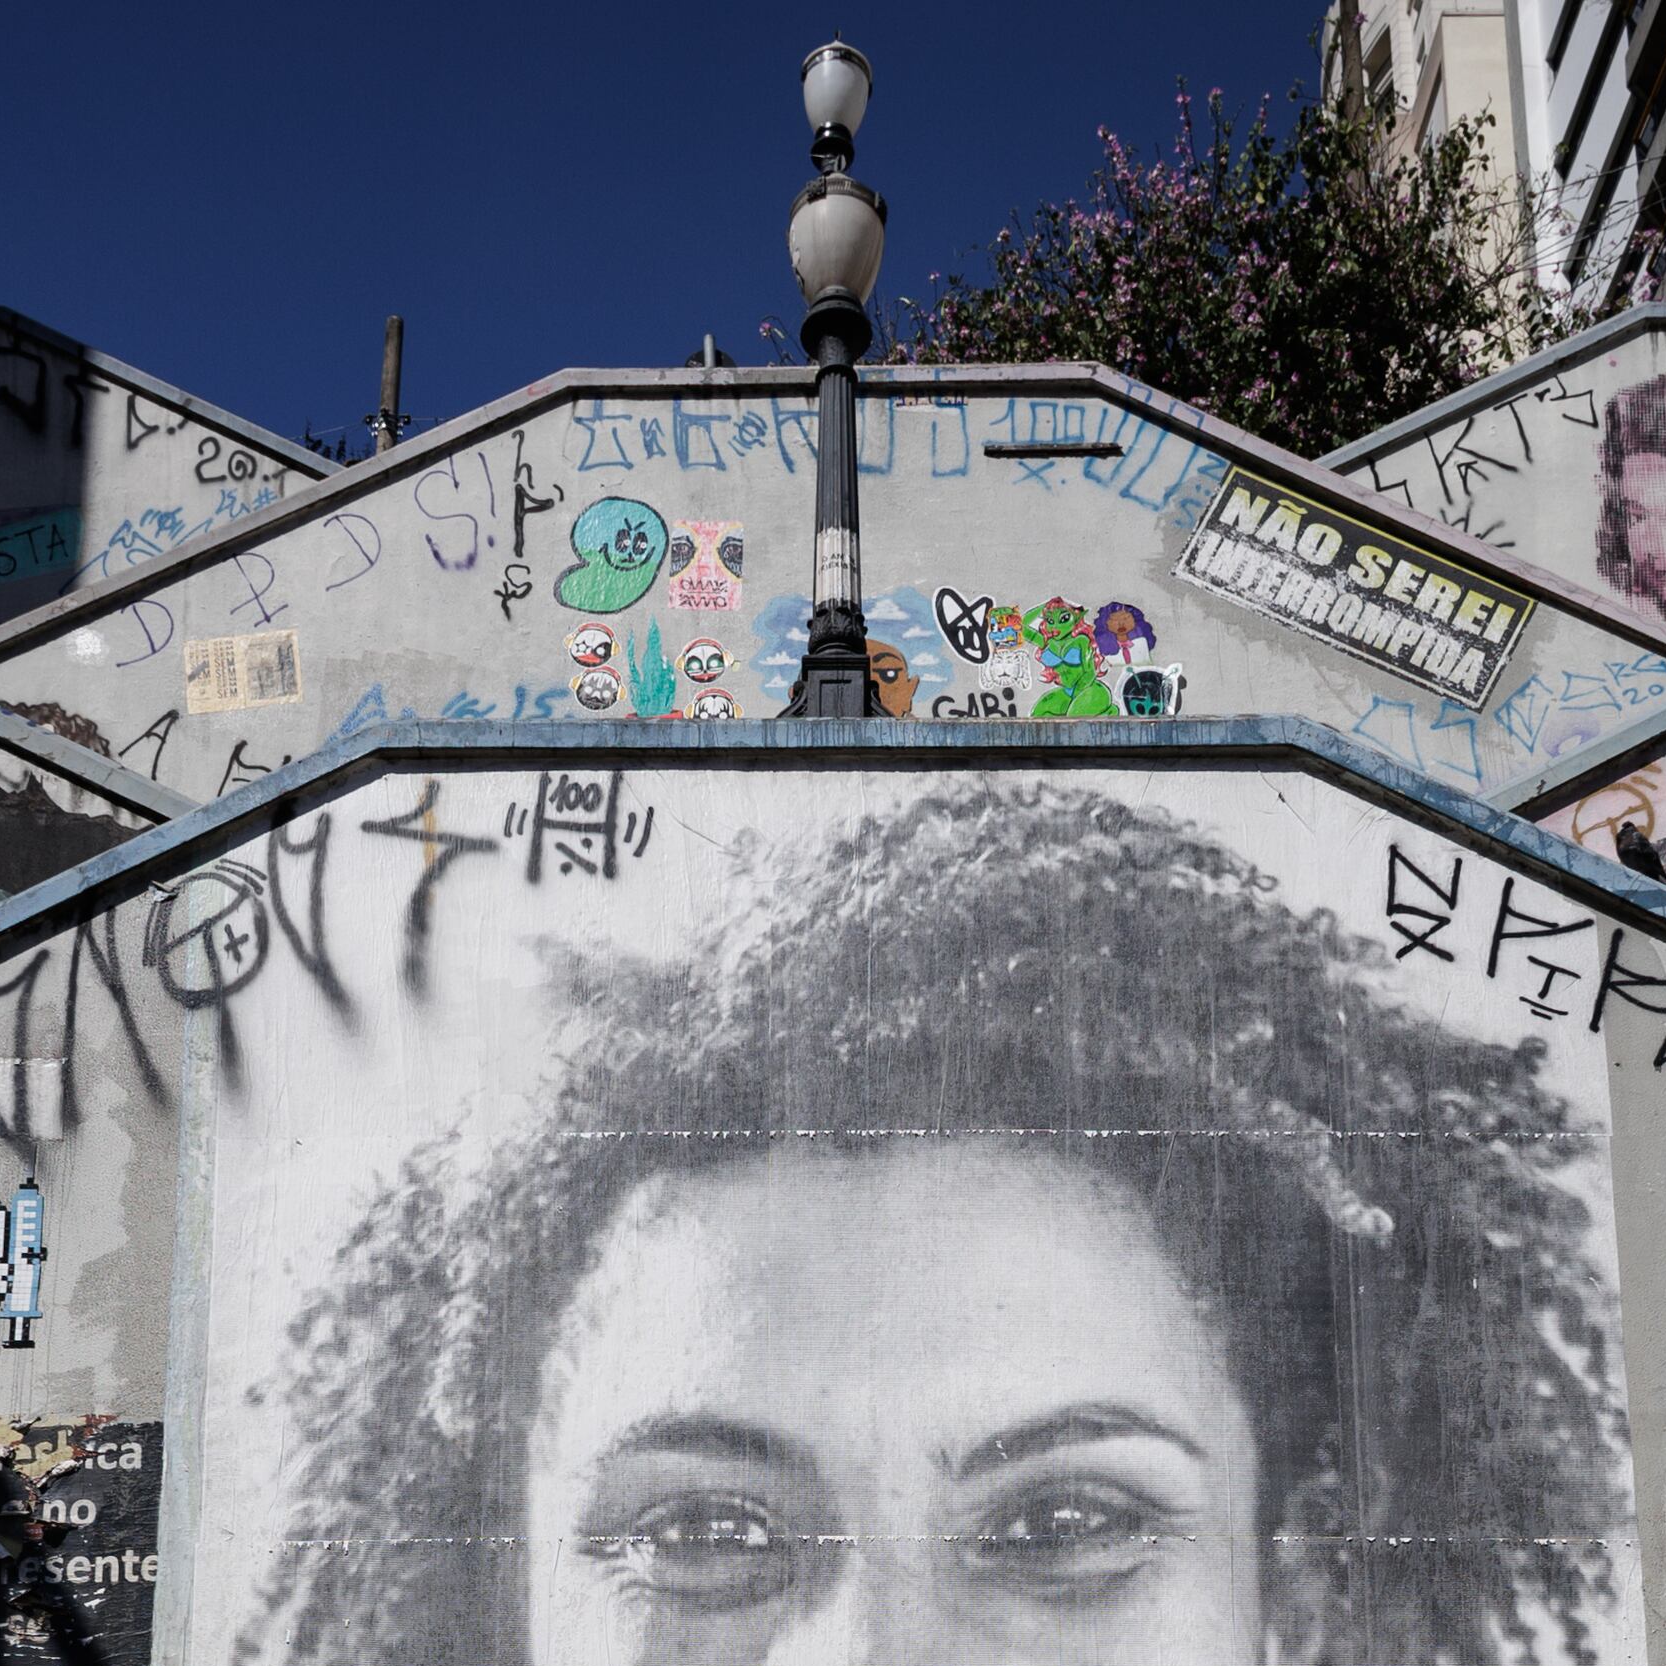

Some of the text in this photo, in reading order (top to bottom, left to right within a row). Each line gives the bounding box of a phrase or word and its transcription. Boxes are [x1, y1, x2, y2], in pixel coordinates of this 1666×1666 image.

[1189, 530, 1487, 693] INTERROMPIDA
[1218, 486, 1516, 645] NÃO SEREI
[41, 1497, 97, 1527] no
